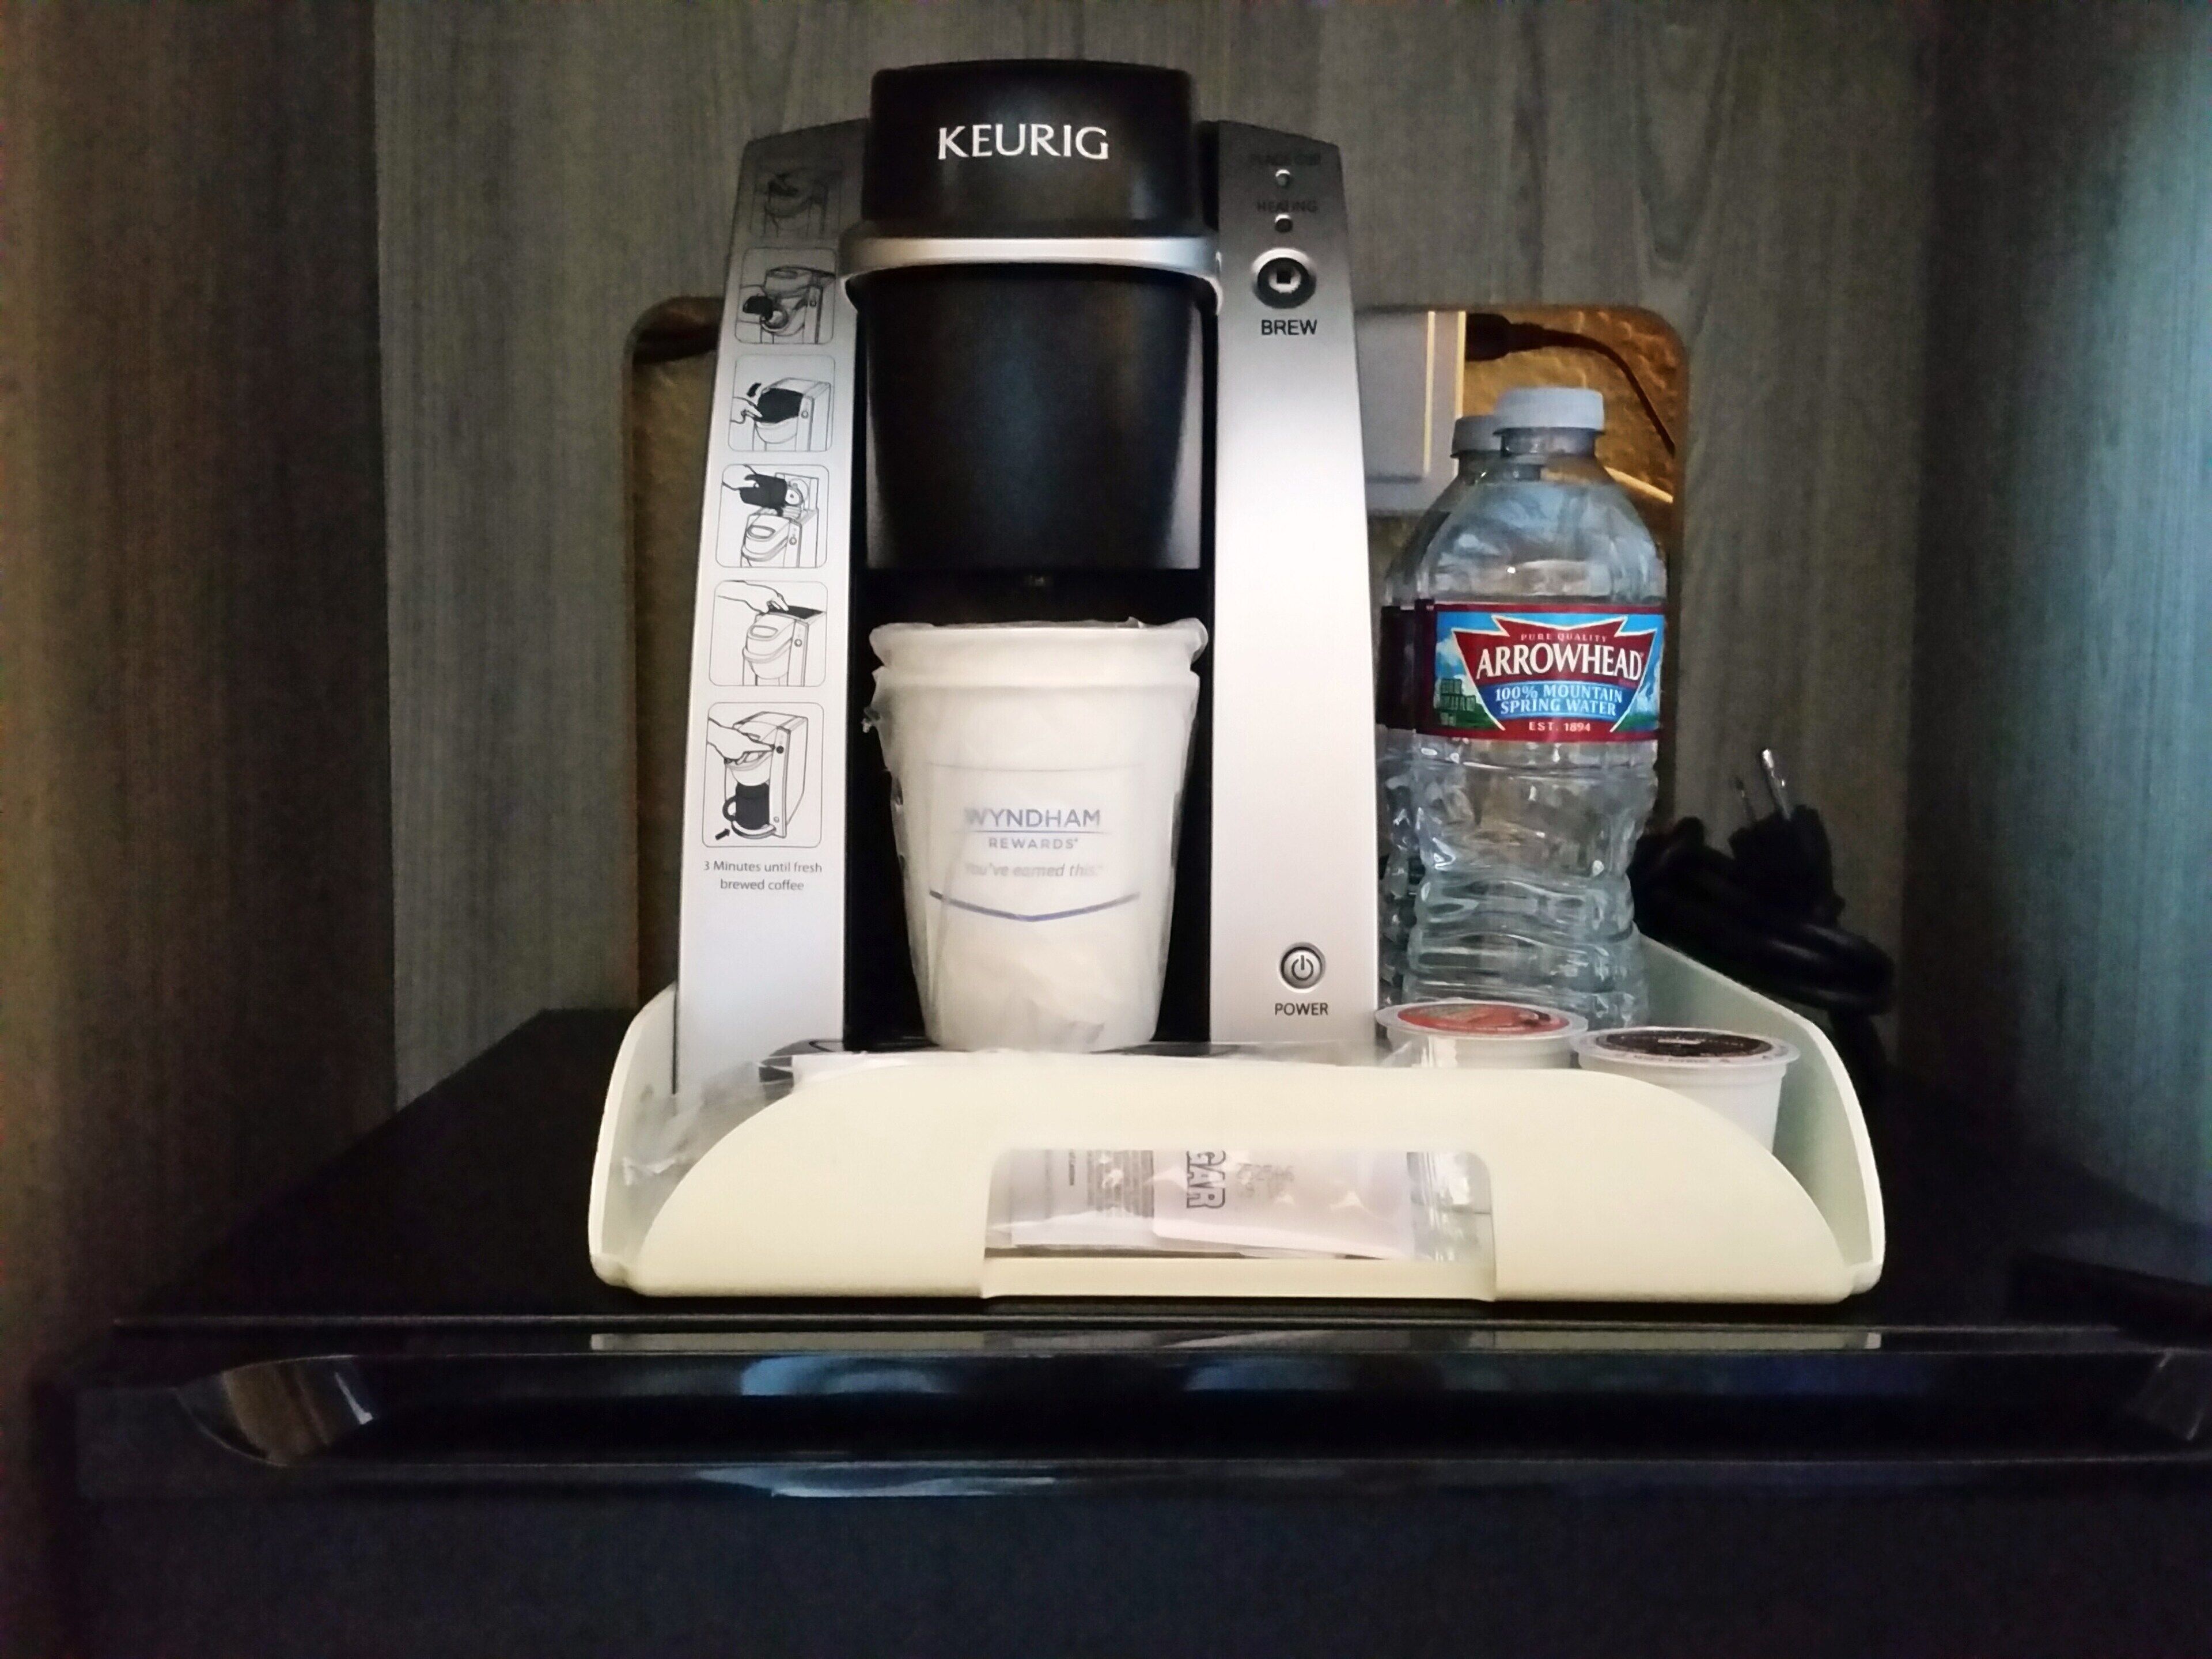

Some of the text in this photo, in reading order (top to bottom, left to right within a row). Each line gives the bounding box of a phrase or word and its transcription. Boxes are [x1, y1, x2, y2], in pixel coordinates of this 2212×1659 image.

[938, 123, 1109, 160] KEURIG
[1262, 319, 1317, 336] BREW
[1521, 633, 1608, 643] PURE QUALITY
[1476, 642, 1643, 680] ARROWHEAD
[1495, 684, 1623, 704] 100% MOUNTAIN
[1501, 698, 1617, 717] SPRING WATER
[1564, 722, 1592, 732] 1894
[964, 807, 1101, 828] WYNDHAM
[703, 860, 823, 873] 3 Minutes until fresh
[720, 878, 804, 891] brewed coffee
[1275, 1002, 1328, 1016] POWER
